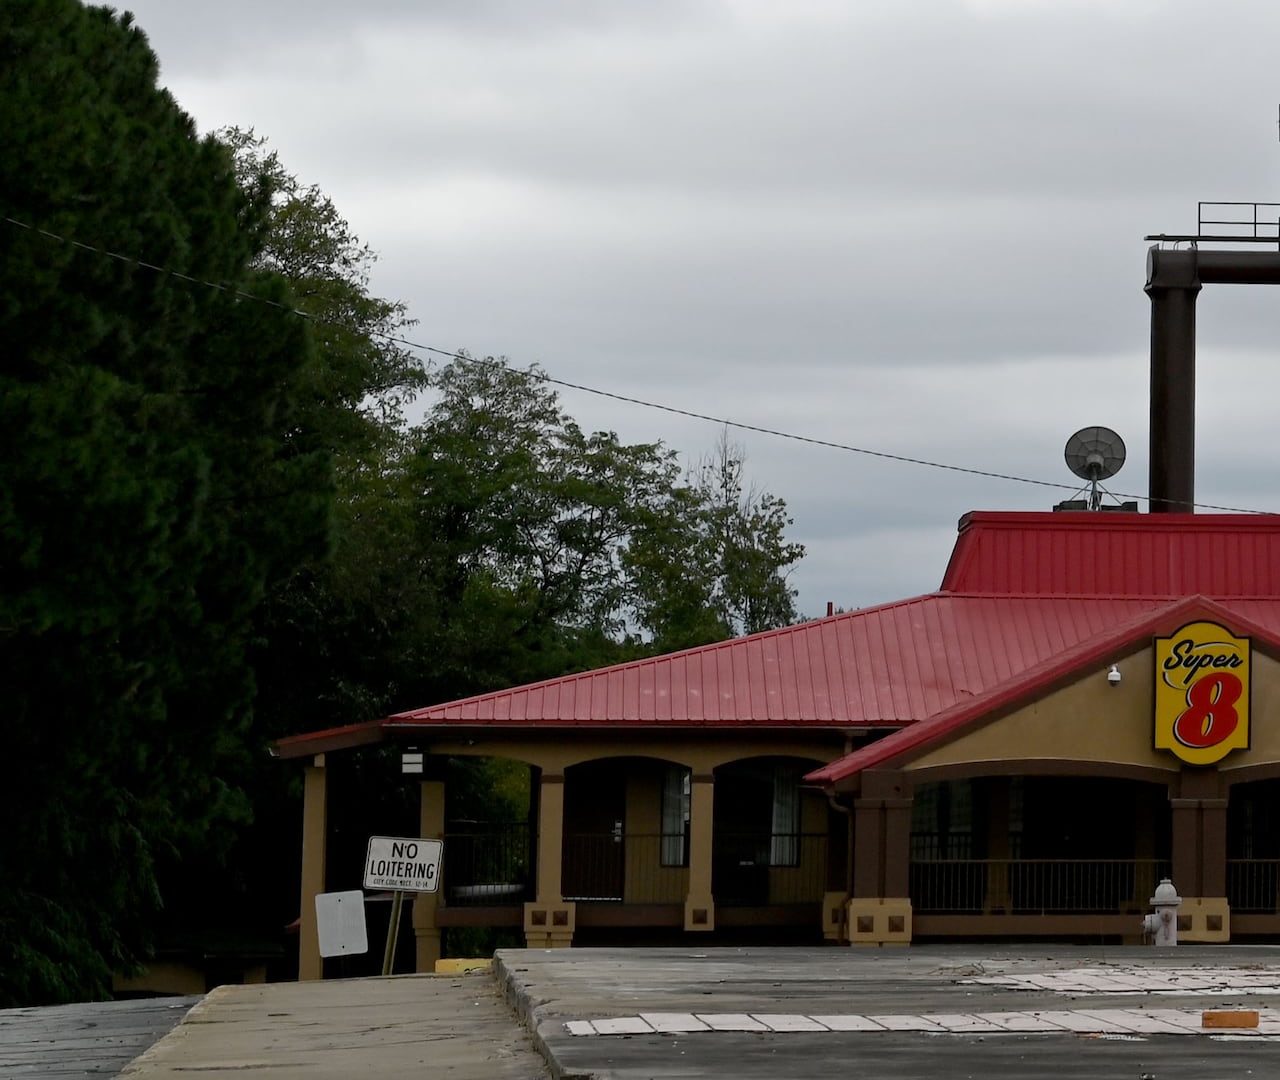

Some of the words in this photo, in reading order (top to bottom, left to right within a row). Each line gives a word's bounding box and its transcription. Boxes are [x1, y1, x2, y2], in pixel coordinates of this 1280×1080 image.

[1163, 639, 1243, 685] Super
[1172, 672, 1243, 748] 8
[392, 842, 418, 859] NO
[370, 860, 435, 879] LOITERING
